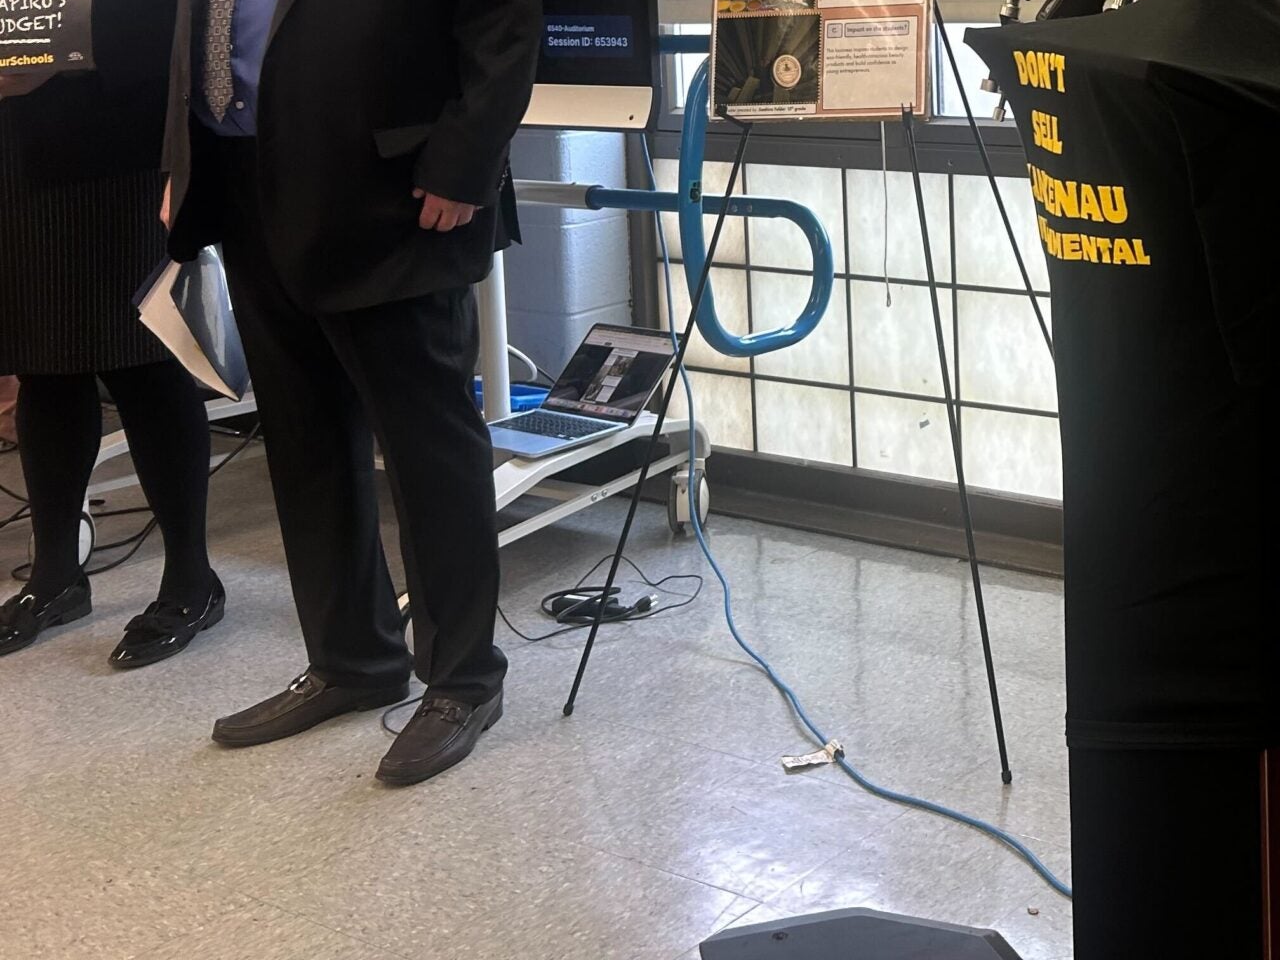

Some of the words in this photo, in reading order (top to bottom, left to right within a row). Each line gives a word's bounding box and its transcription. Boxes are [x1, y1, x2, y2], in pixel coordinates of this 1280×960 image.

[0, 11, 62, 34] UDGET!
[548, 37, 580, 46] Session
[582, 37, 593, 46] ID:
[595, 37, 628, 47] 653943
[0, 53, 54, 67] urSchools
[1013, 50, 1066, 93] DON'T
[1031, 109, 1063, 155] SELL
